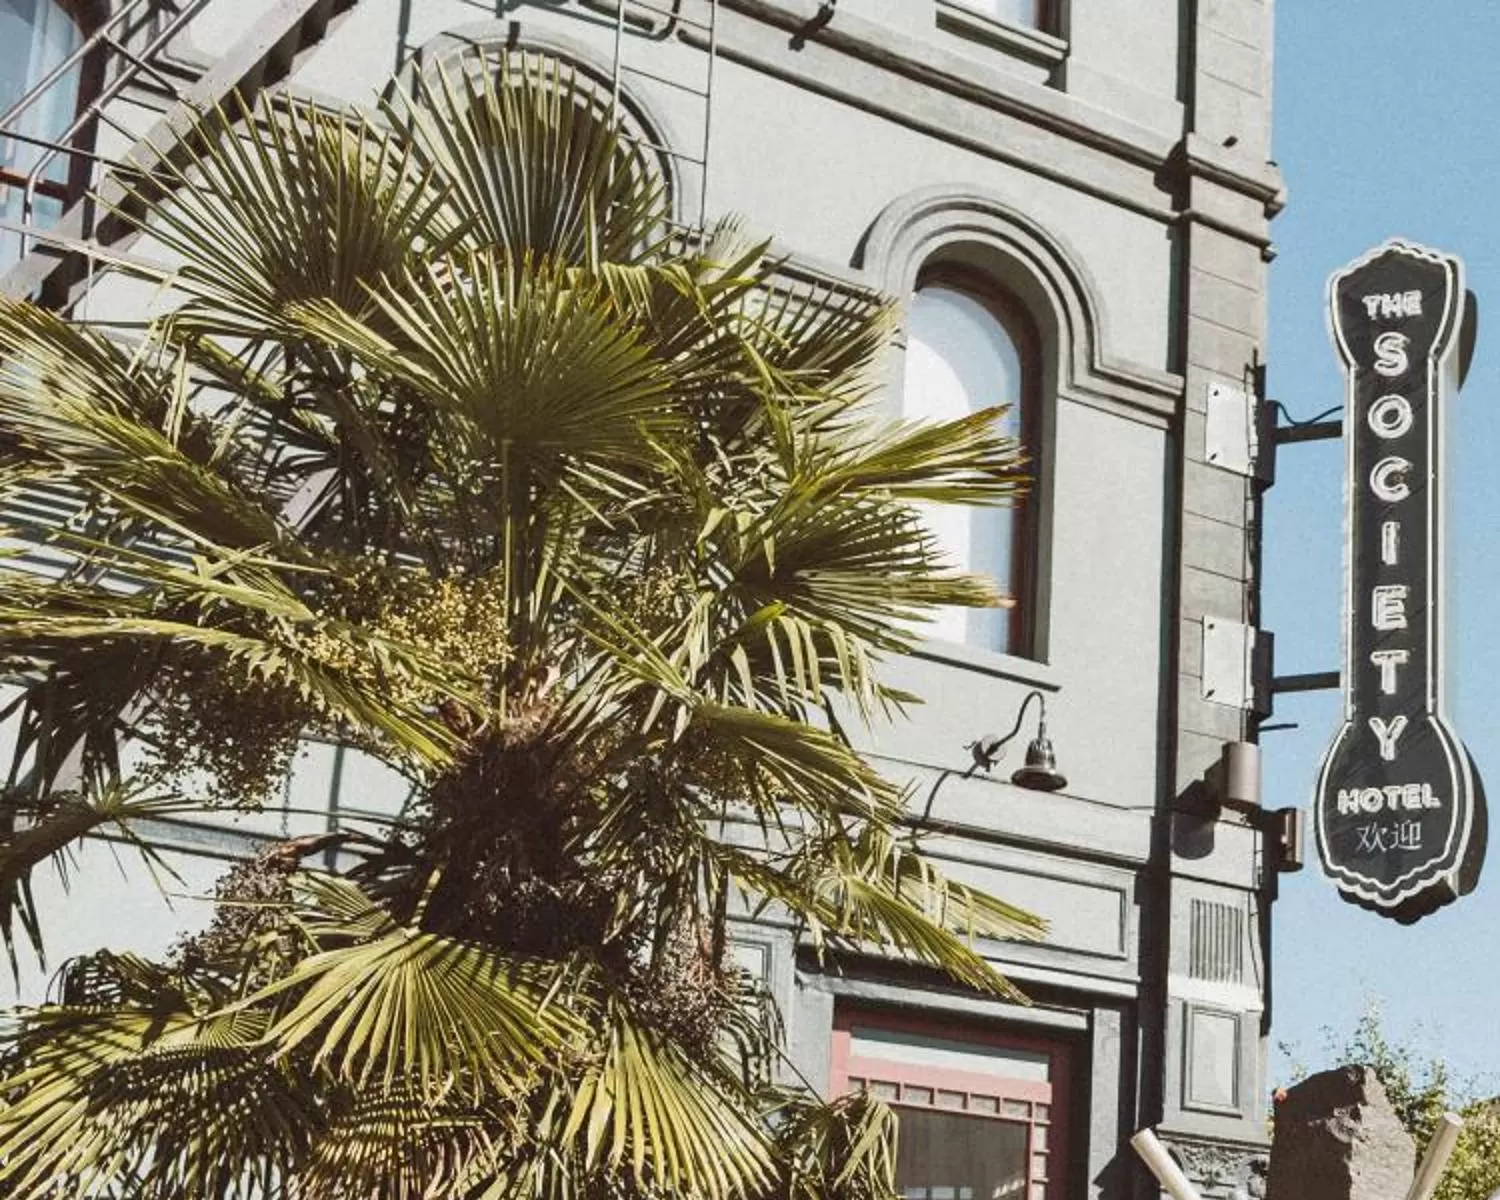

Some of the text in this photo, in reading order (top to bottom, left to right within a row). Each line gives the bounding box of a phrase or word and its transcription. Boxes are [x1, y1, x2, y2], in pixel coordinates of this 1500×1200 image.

[1361, 289, 1422, 320] THE
[1367, 331, 1414, 761] SOCIETY
[1336, 783, 1441, 815] HOTEL
[1356, 819, 1423, 853] 欢迎
